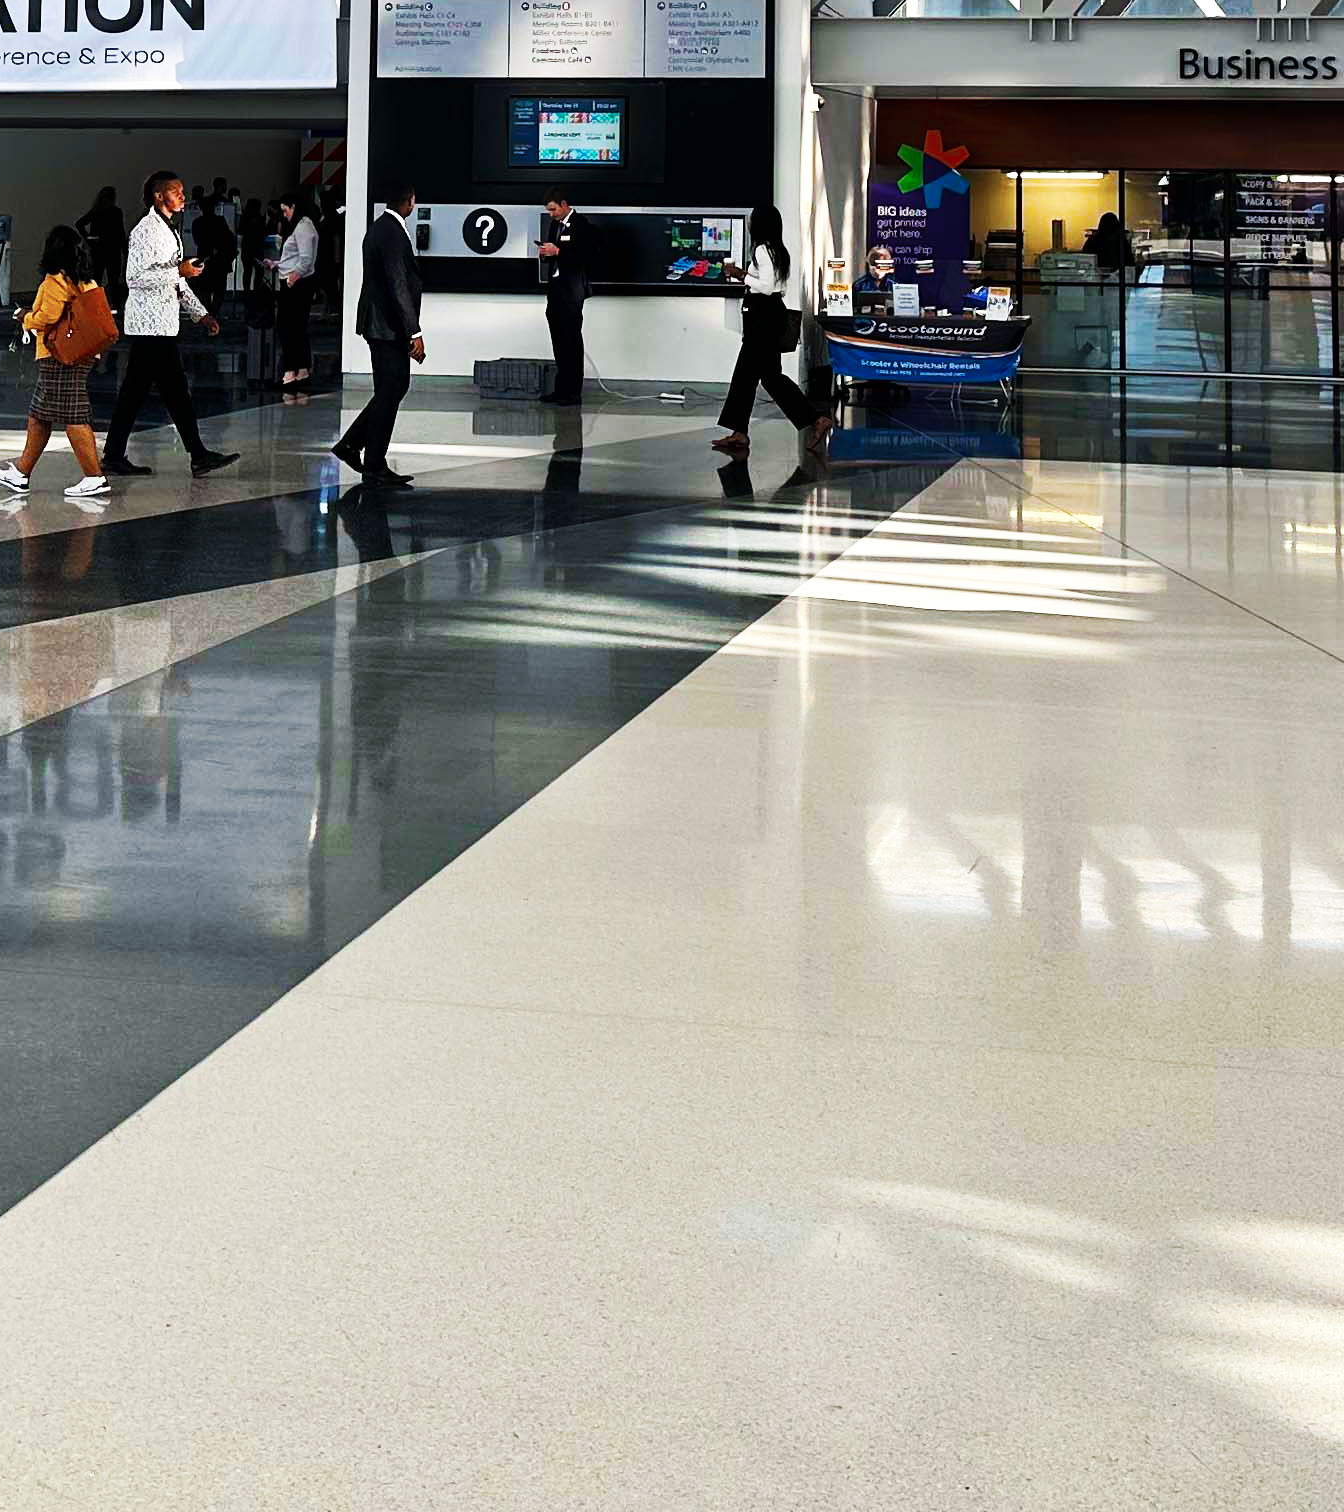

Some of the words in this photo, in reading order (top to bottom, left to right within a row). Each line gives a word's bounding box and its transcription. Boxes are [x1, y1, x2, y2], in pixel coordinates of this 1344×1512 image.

[78, 48, 96, 65] &
[104, 48, 165, 69] Expo
[1180, 49, 1337, 80] Business
[877, 205, 896, 216] BIG
[899, 205, 927, 217] ideas
[876, 218, 892, 229] get
[894, 218, 926, 229] printed
[877, 229, 898, 239] right
[877, 322, 987, 336] Scootaround
[861, 359, 891, 368] Scooter
[900, 361, 948, 369] Wheelchair
[949, 362, 981, 370] Rentals
